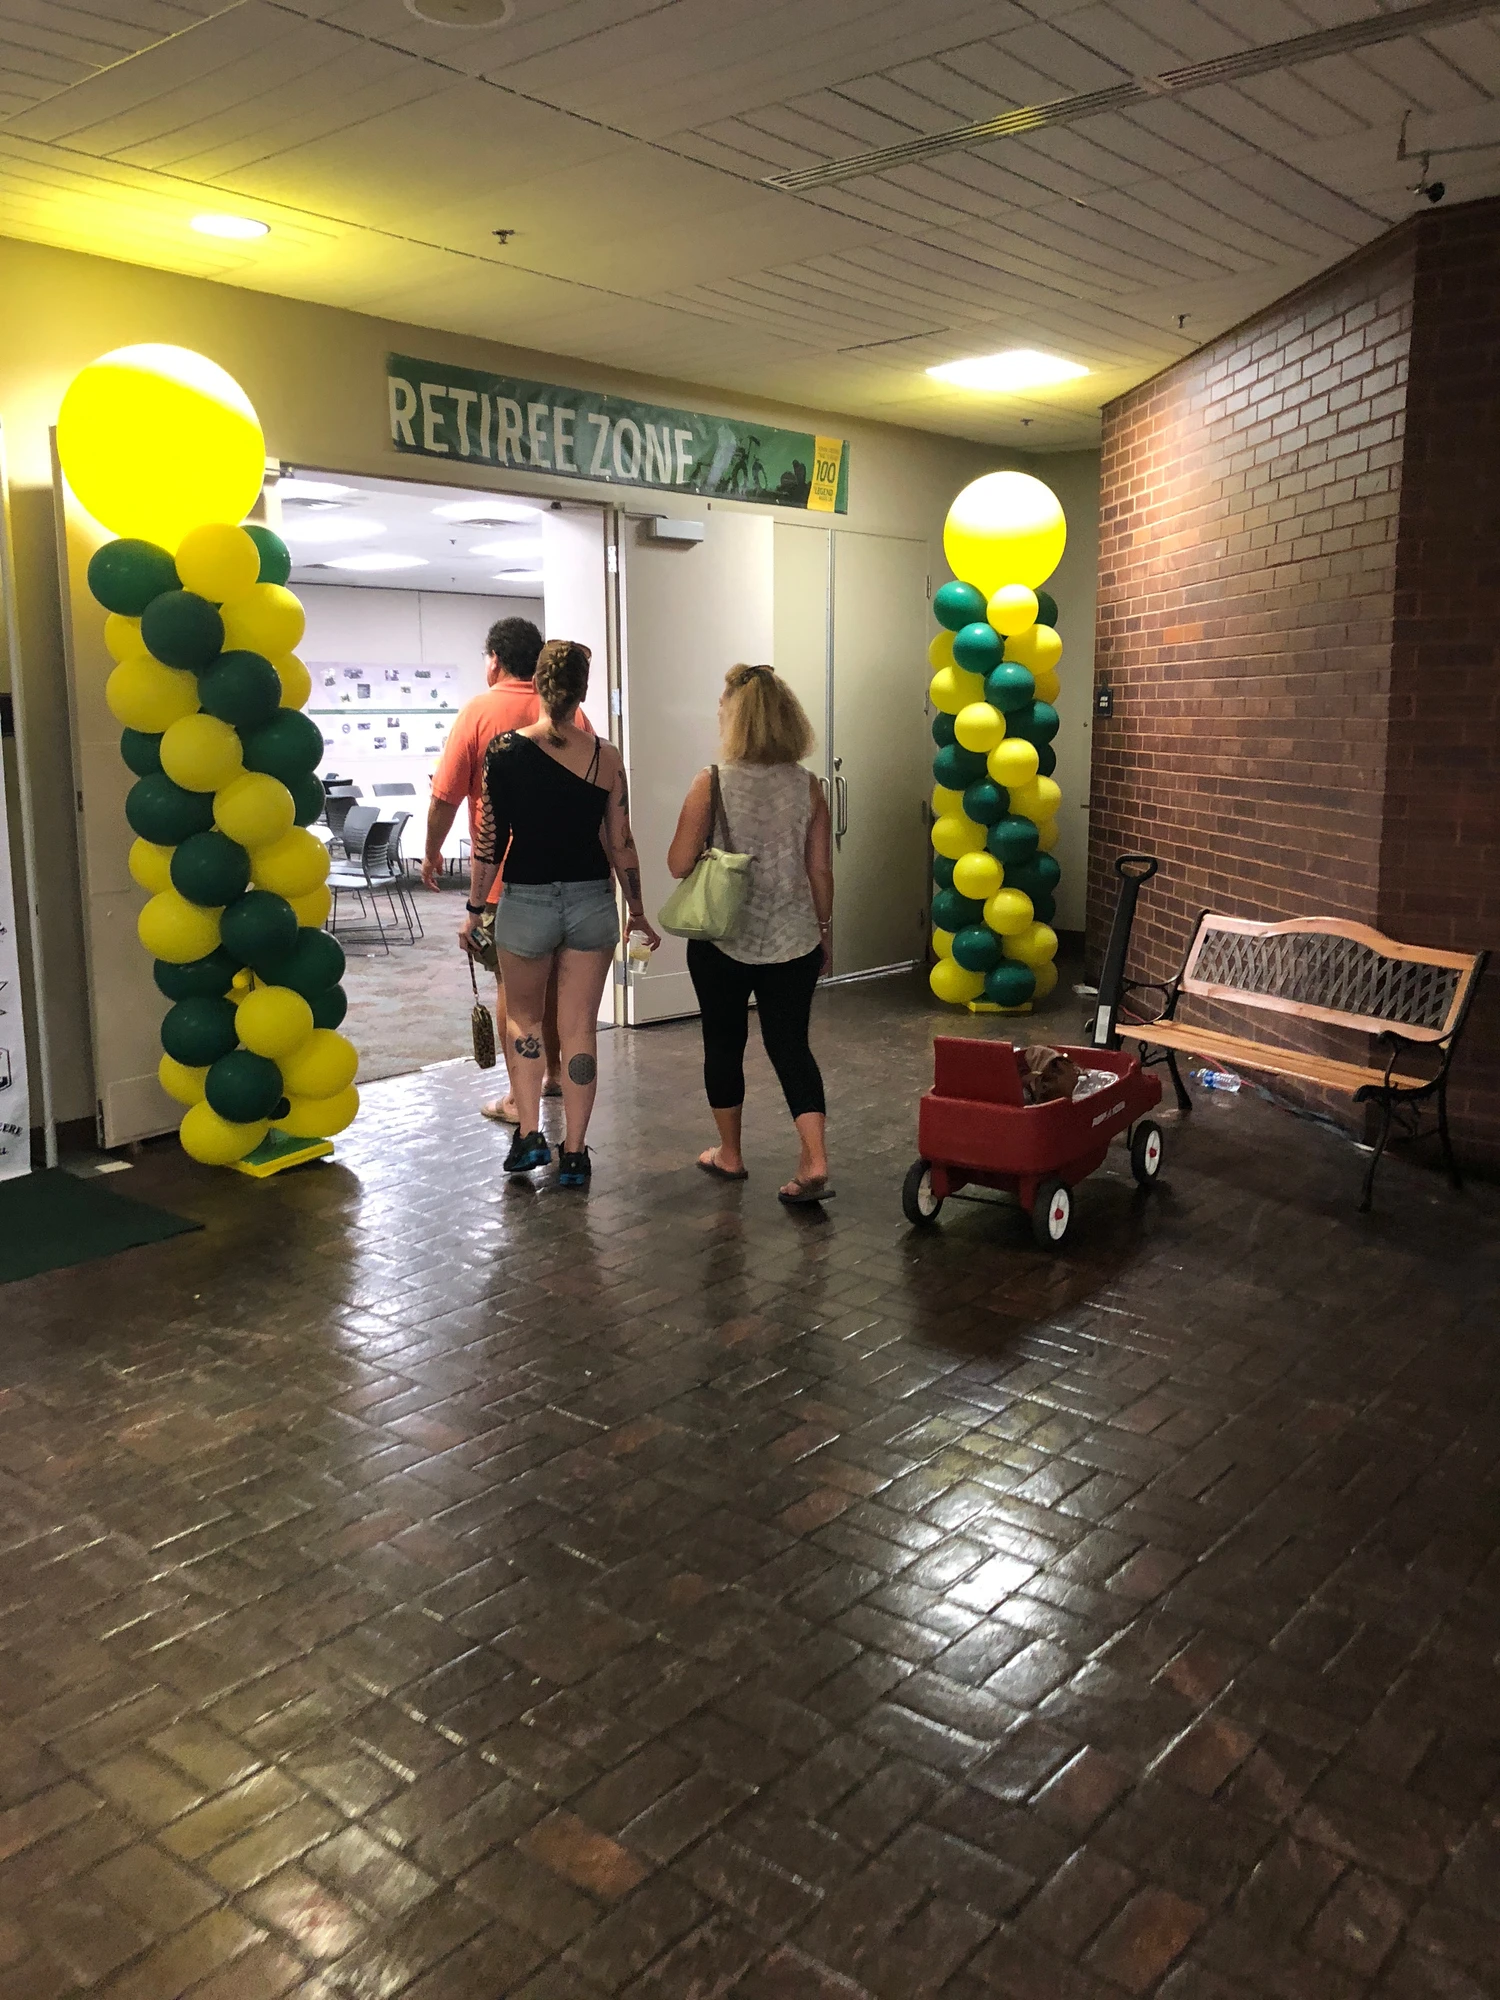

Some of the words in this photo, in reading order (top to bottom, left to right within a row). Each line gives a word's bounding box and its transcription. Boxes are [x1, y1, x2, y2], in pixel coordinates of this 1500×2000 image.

[388, 377, 577, 472] RETIREE
[587, 415, 694, 484] ZONE
[816, 460, 836, 483] 100
